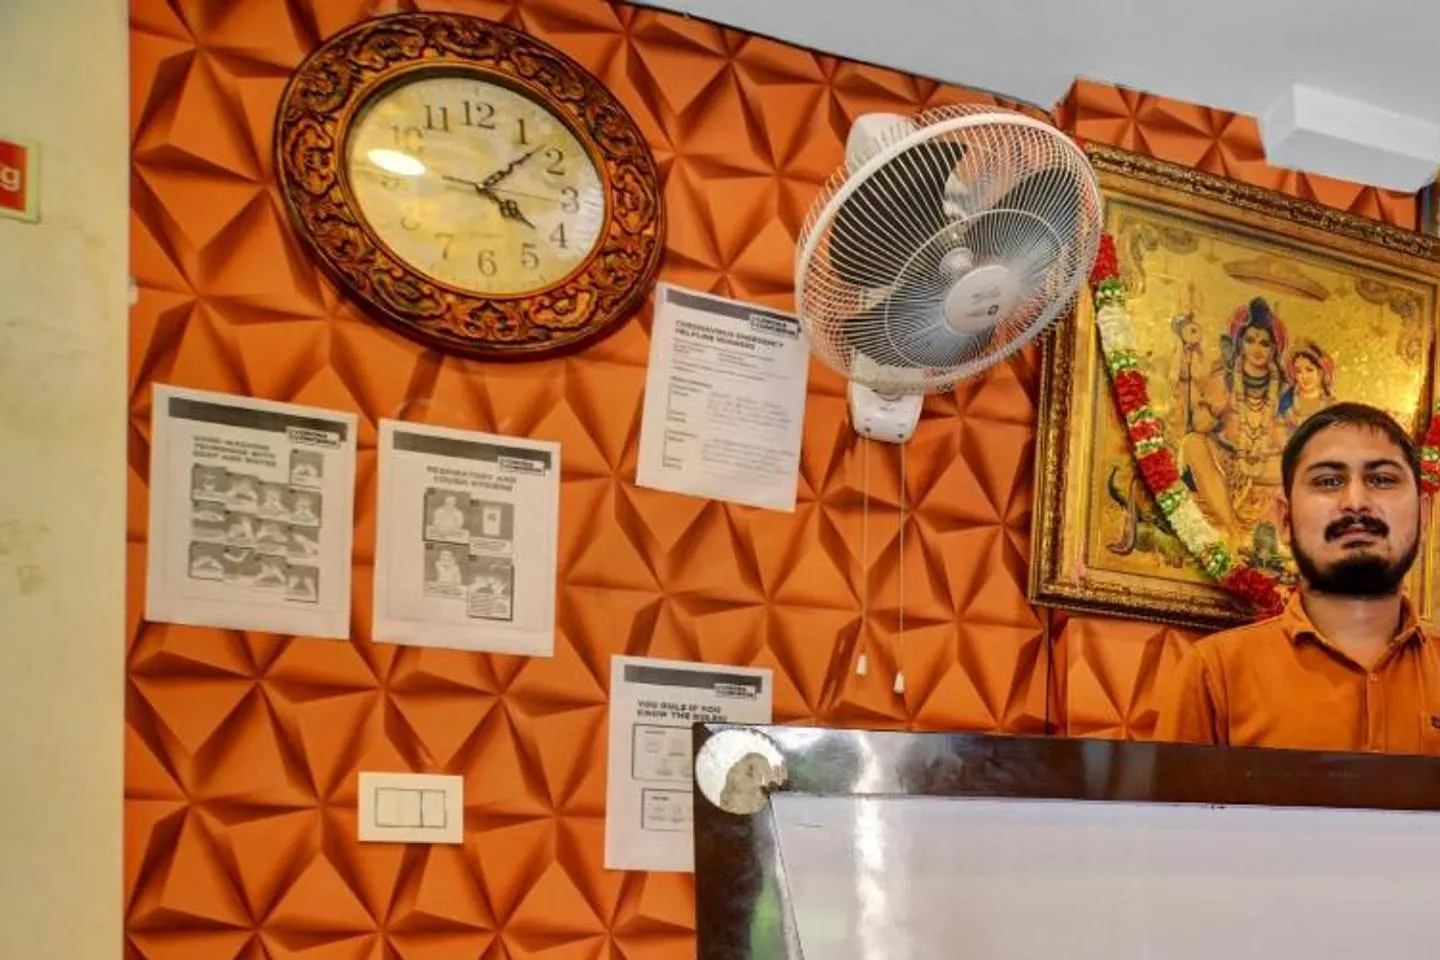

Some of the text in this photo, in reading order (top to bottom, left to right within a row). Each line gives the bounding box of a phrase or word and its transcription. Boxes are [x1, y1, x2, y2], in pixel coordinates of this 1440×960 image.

[423, 104, 450, 133] 11
[462, 101, 496, 130] 12
[514, 118, 530, 145] 1
[544, 148, 565, 176] 2
[560, 186, 580, 214] 3
[434, 232, 455, 260] 7
[550, 222, 569, 249] 4
[477, 249, 498, 277] 6
[521, 243, 540, 270] 5
[637, 699, 658, 709] YOU
[671, 711, 690, 719] THE
